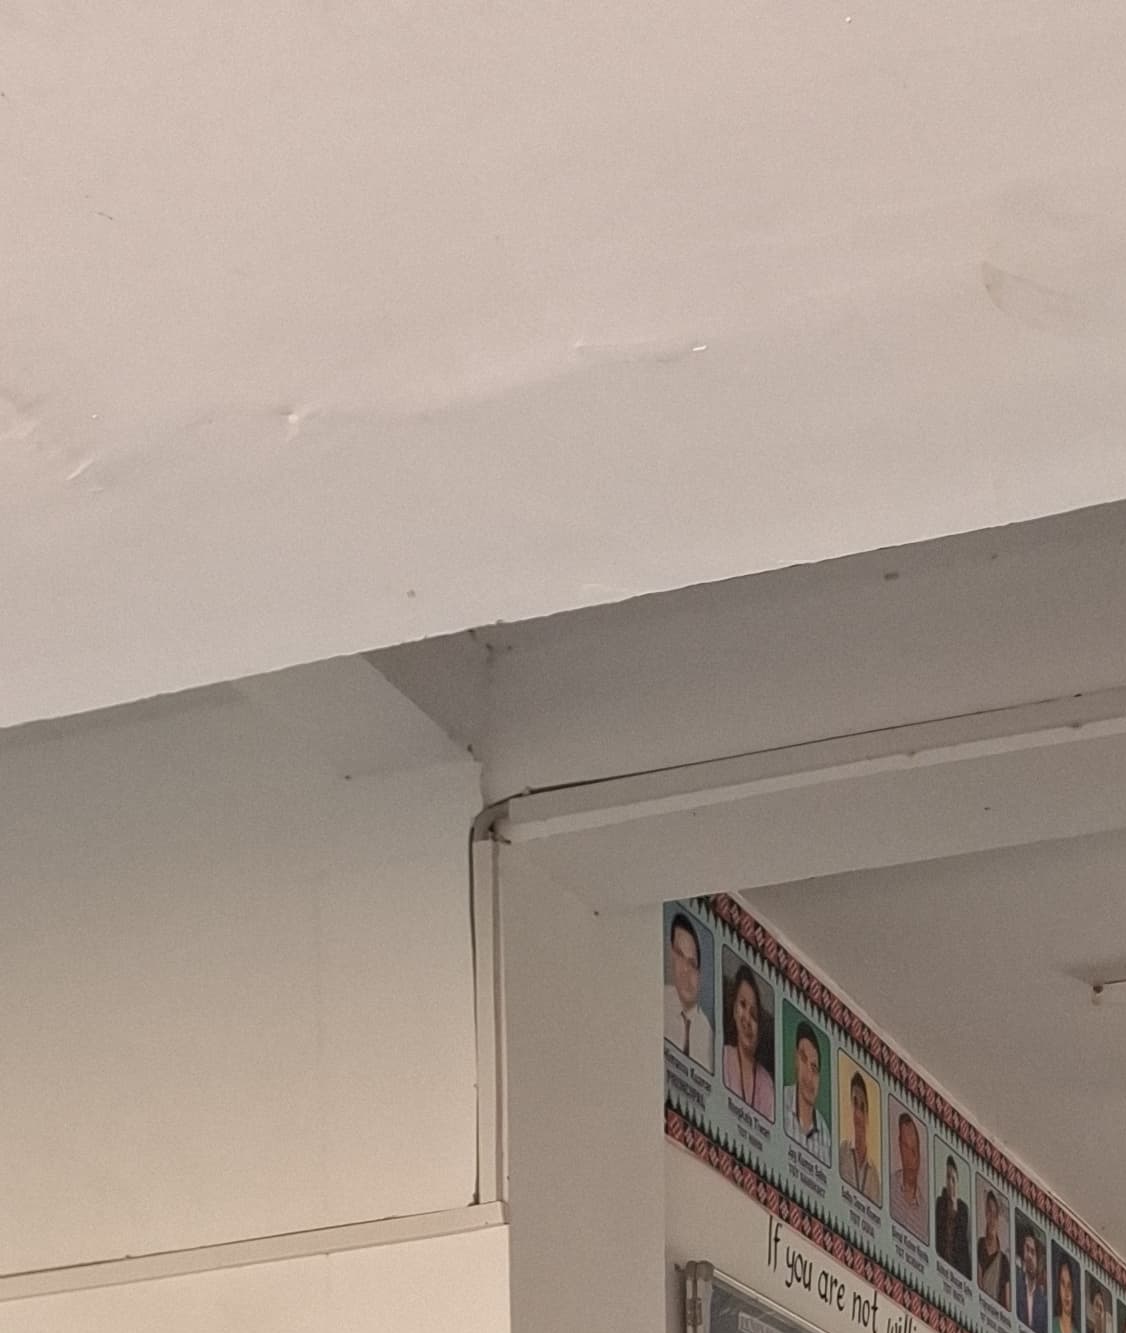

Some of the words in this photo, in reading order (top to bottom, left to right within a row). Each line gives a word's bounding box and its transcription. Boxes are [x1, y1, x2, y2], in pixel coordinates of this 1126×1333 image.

[767, 1214, 782, 1272] If
[785, 1246, 813, 1291] you
[818, 1270, 845, 1311] are
